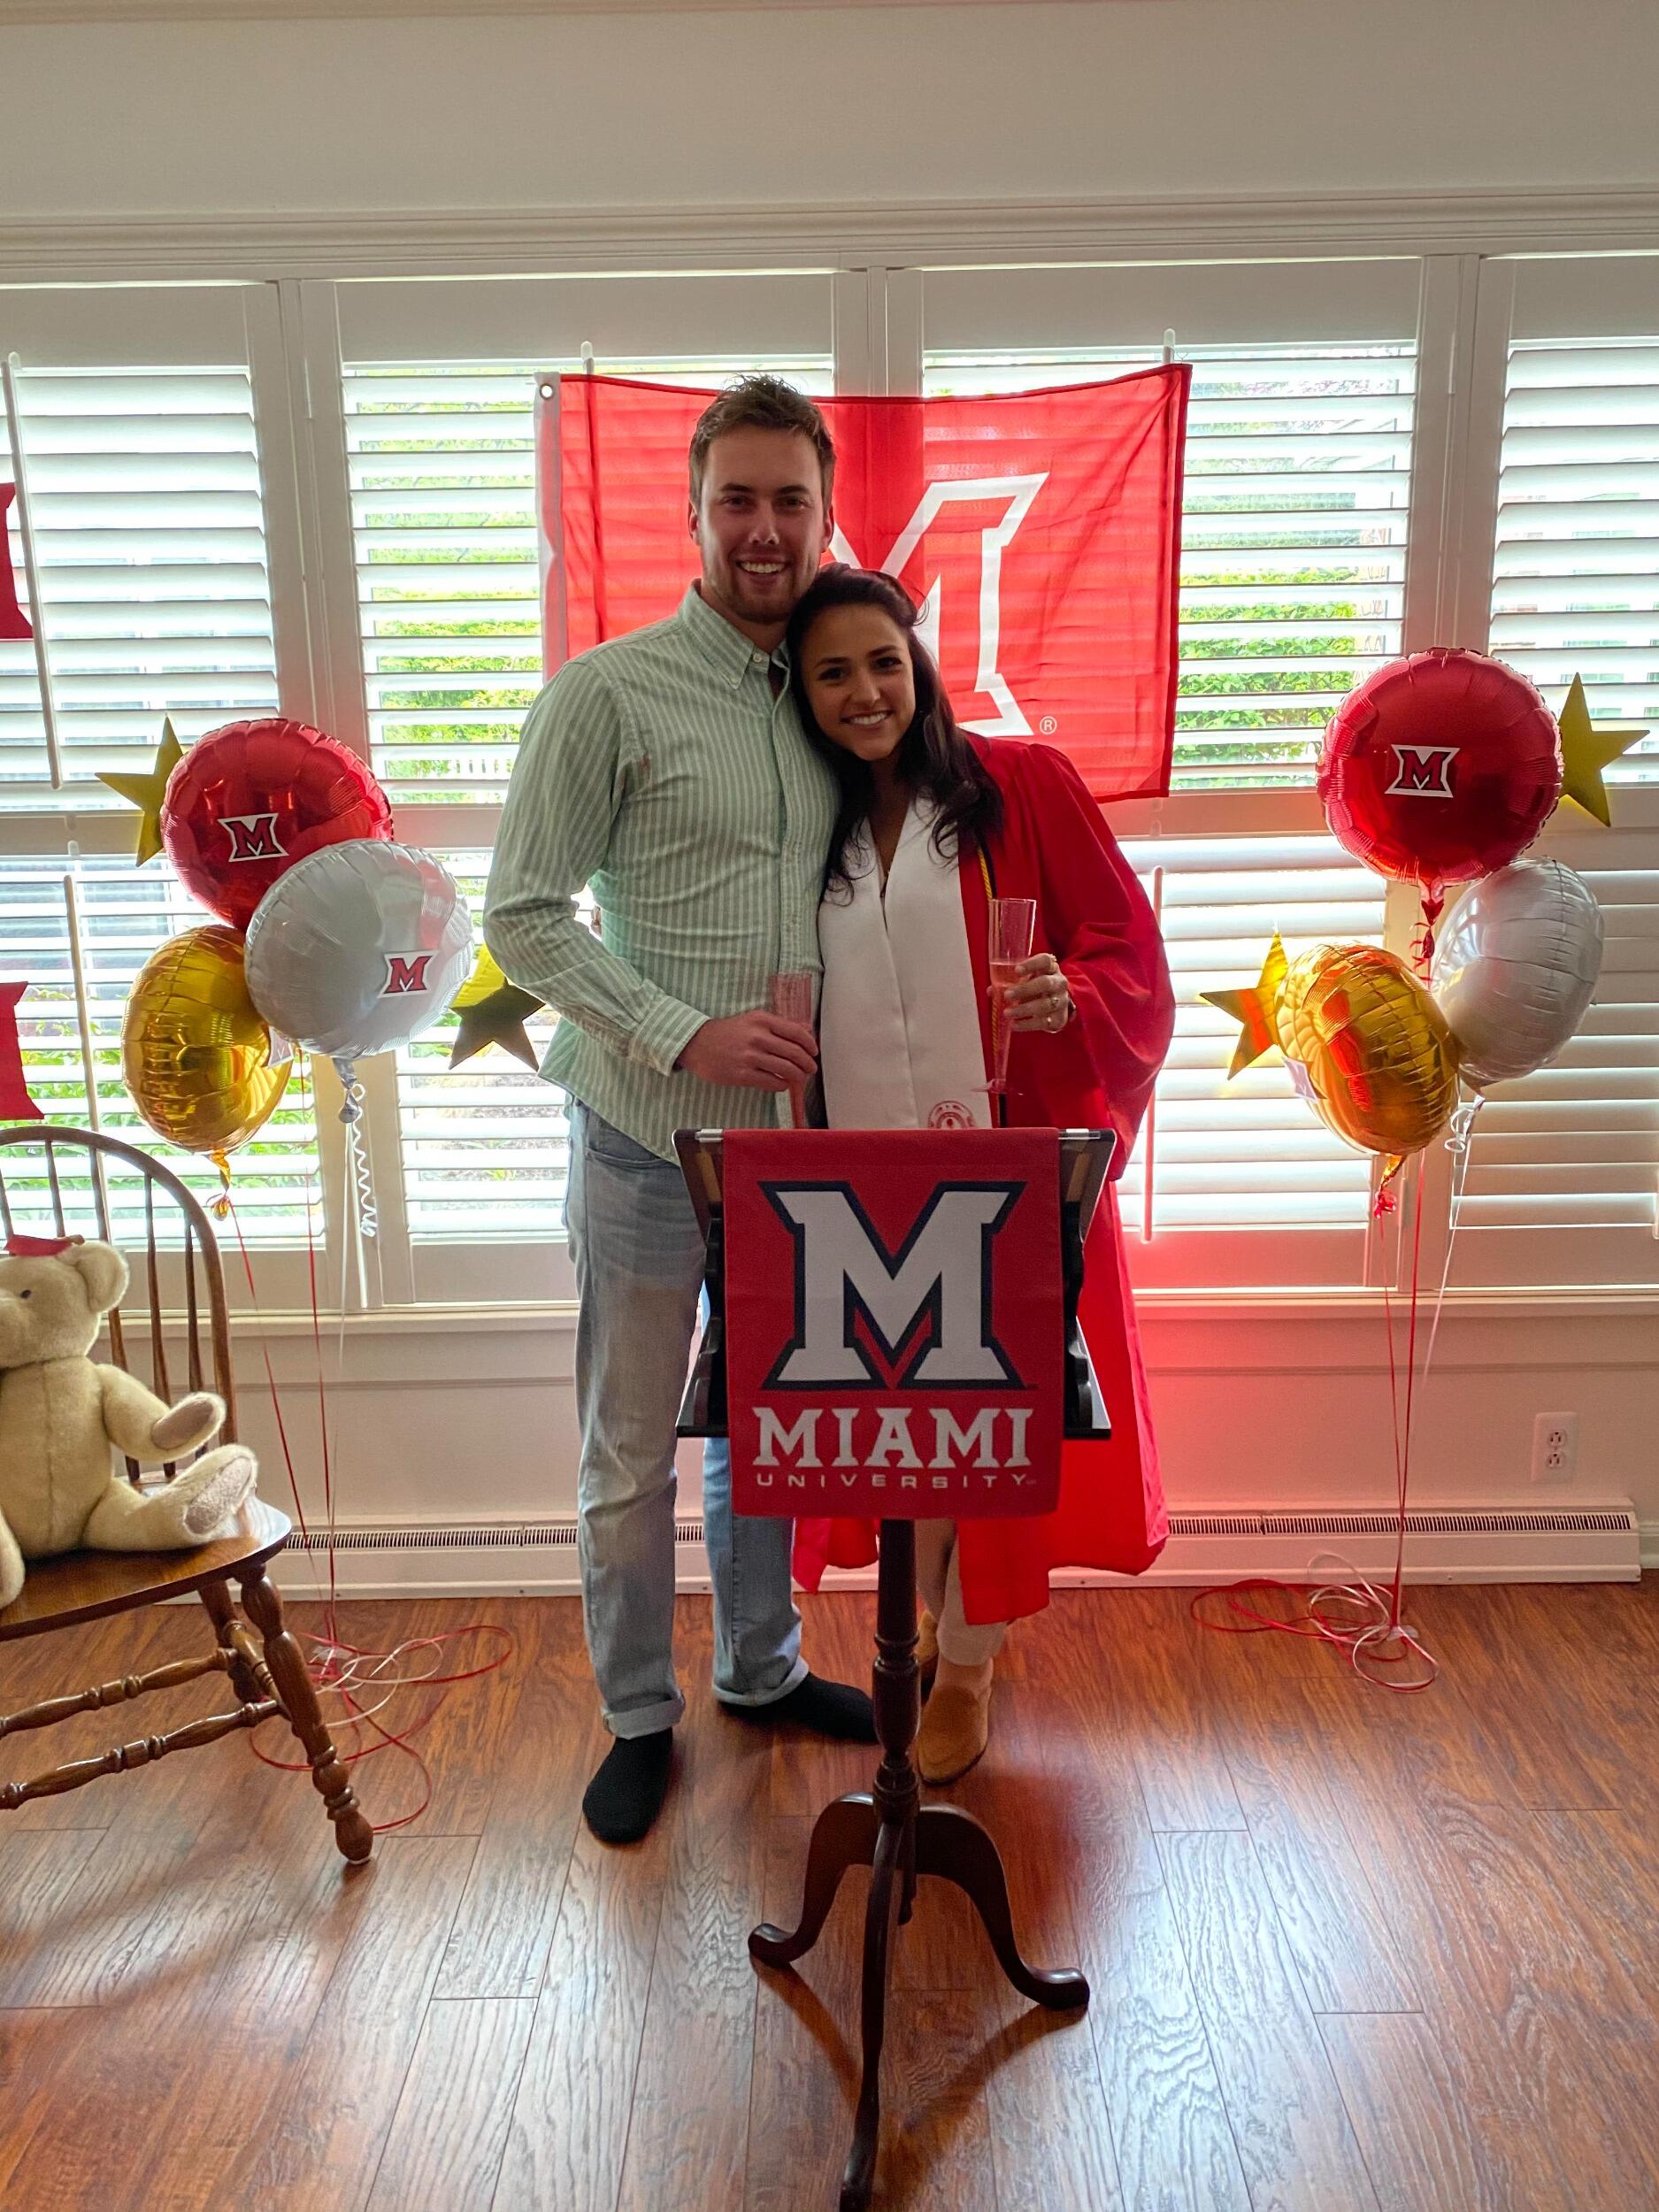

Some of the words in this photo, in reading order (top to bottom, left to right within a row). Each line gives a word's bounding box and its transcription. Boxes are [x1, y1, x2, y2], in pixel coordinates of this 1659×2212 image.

[1394, 749, 1452, 792] M
[224, 816, 282, 859] M
[383, 956, 434, 994] M
[757, 1180, 1028, 1390] M
[752, 1407, 1034, 1469] MIAMI
[757, 1473, 1026, 1489] UNIVERSITY
